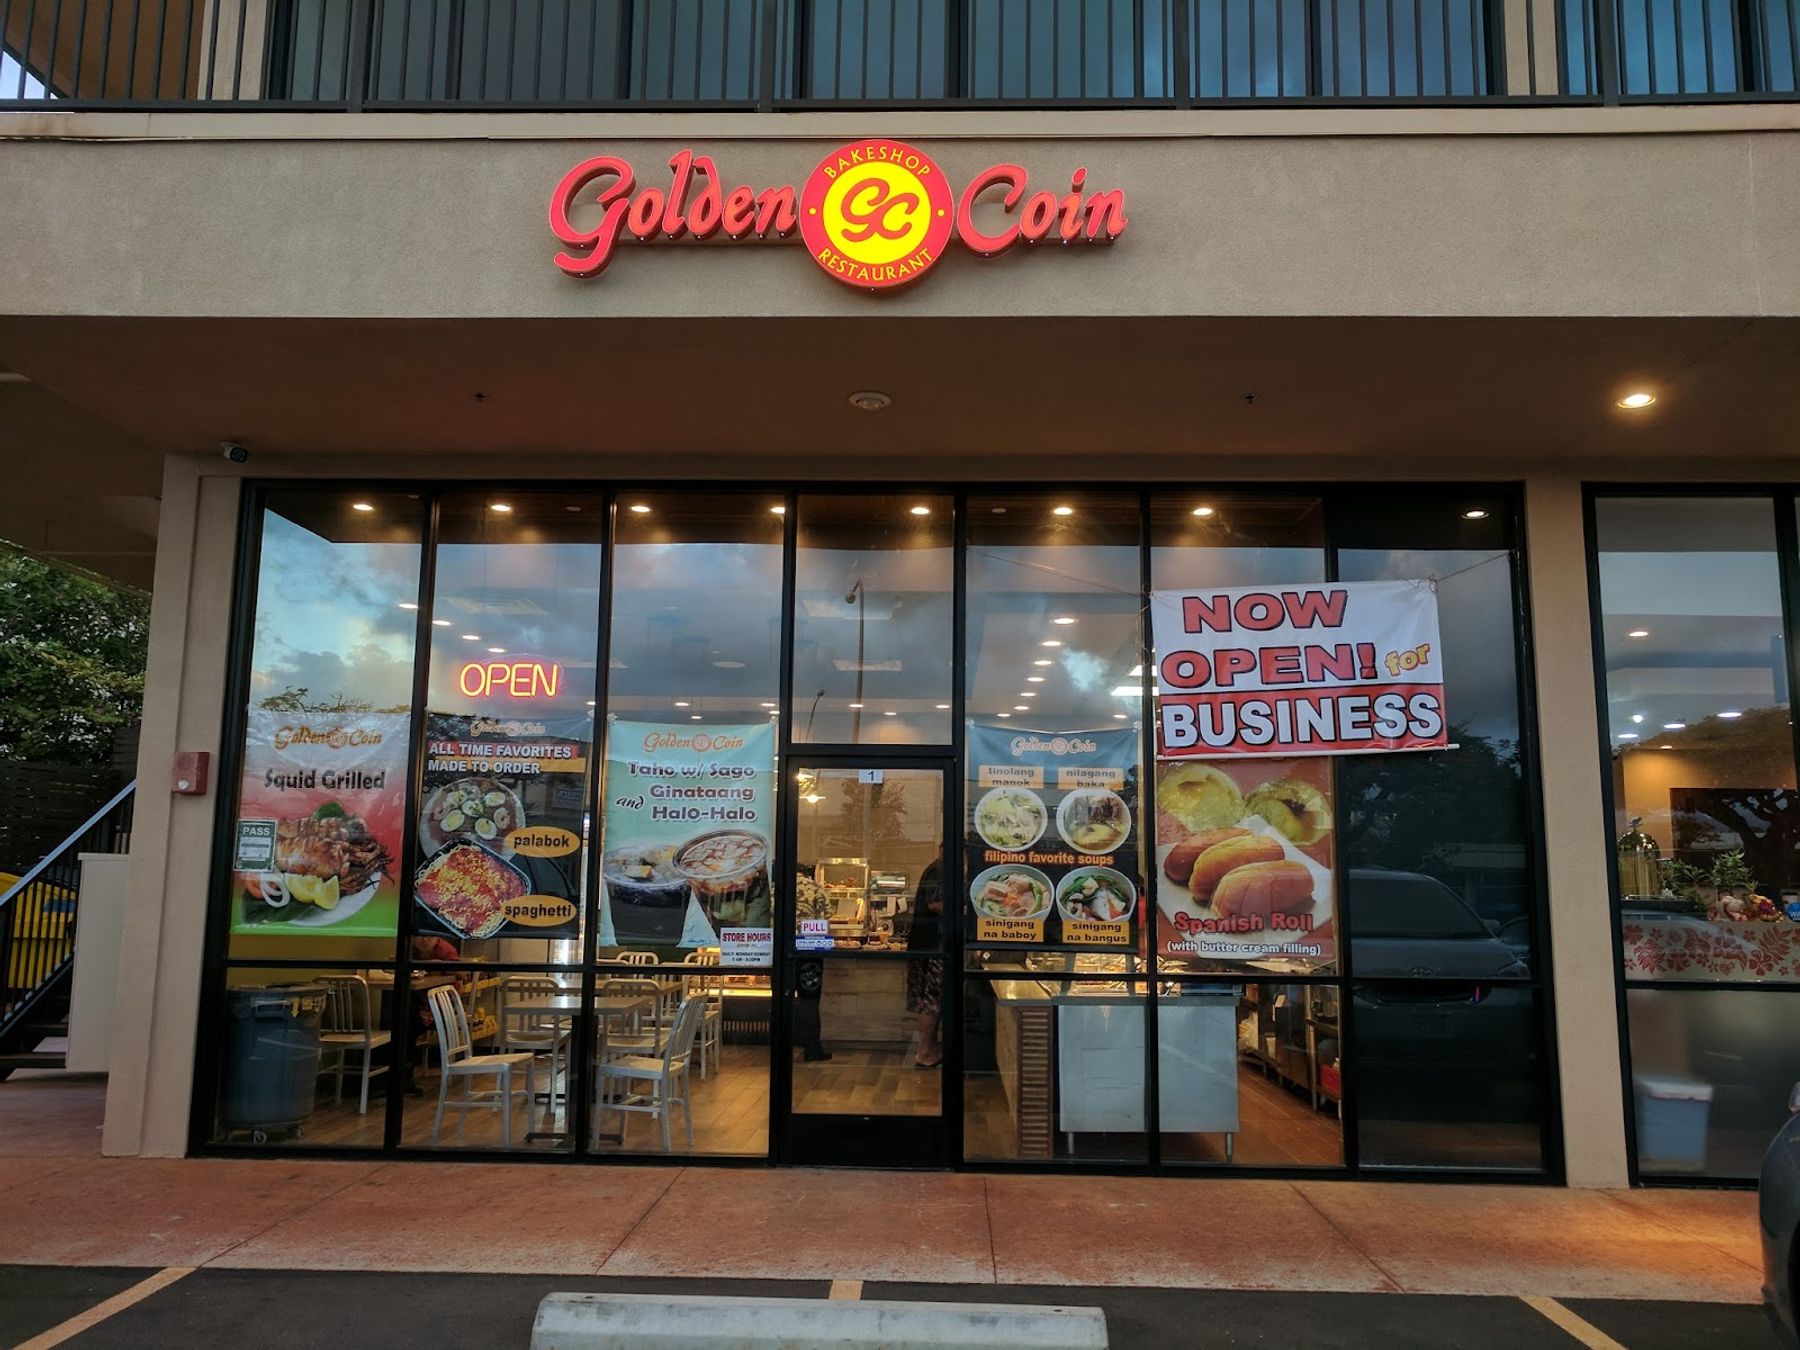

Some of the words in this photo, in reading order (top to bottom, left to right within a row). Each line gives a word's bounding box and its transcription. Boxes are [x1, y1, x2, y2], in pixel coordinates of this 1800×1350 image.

[823, 146, 931, 179] BAKESHOP
[549, 149, 797, 278] Golden
[956, 167, 1129, 258] Coin
[818, 247, 933, 282] RESTAURANT
[1182, 589, 1348, 634] NOW
[1161, 642, 1379, 689] OPEN!
[1384, 643, 1431, 677] for
[459, 663, 559, 698] OPEN
[1161, 693, 1443, 748] BUSINESS
[429, 742, 454, 755] ALL
[459, 744, 493, 756] TIME
[495, 745, 572, 759] FAVORITES
[643, 732, 690, 753] Golden
[713, 735, 744, 751] Coin
[428, 760, 467, 772] MADE
[471, 761, 489, 773] TO
[493, 761, 541, 774] ORDER
[628, 761, 675, 776] Taho
[681, 762, 704, 777] w/
[710, 762, 755, 779] Sago
[988, 767, 1035, 778] tinolang
[1066, 768, 1116, 779] nilagang
[264, 767, 317, 792] Squid
[321, 770, 385, 790] Grilled
[868, 770, 875, 781] 1
[992, 779, 1031, 787] manok
[1076, 780, 1105, 788] baka
[650, 784, 754, 801] Ginataang
[616, 795, 644, 810] and
[652, 805, 756, 820] Halo-Halo
[242, 826, 270, 836] PASS
[513, 833, 570, 849] palabok
[984, 851, 1026, 865] filipino
[1029, 851, 1075, 864] favorite
[1078, 854, 1114, 867] soups
[505, 903, 572, 919] spaghetti
[803, 922, 826, 932] PULL
[985, 919, 1035, 930] sinigang
[1072, 922, 1122, 933] sinigang
[1174, 911, 1264, 935] Spanish
[1270, 911, 1314, 932] Roll
[722, 932, 745, 942] STORE
[746, 932, 772, 942] HOURS
[1002, 930, 1037, 941] baboy
[1084, 933, 1128, 944] bangus
[1167, 940, 1198, 953] (with
[1201, 941, 1238, 953] butter
[1238, 944, 1280, 954] cream
[1283, 942, 1321, 957] filling)
